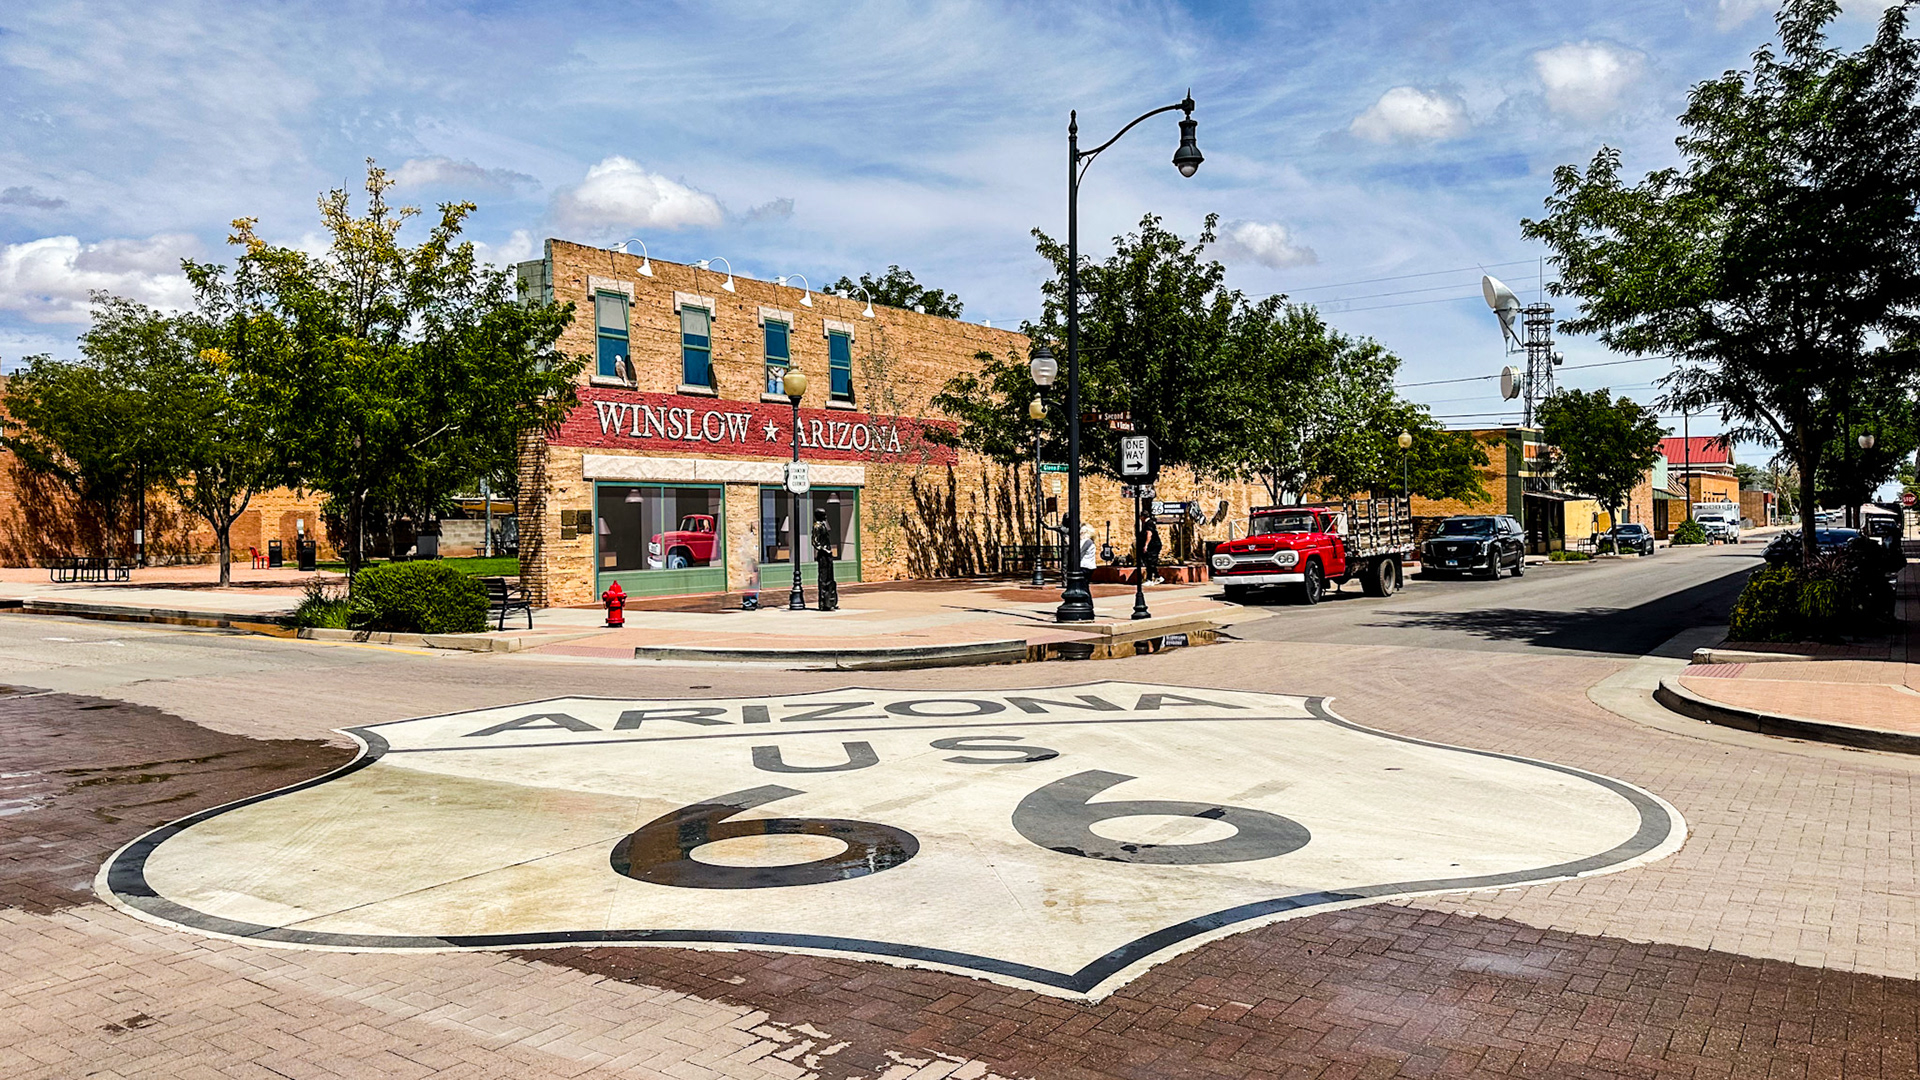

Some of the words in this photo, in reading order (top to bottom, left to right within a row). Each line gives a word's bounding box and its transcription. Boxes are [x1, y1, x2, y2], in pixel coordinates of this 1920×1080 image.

[593, 400, 752, 443] WINSLOW
[789, 416, 902, 454] ARIZONA
[1126, 440, 1145, 450] ONE
[1125, 450, 1145, 460] WAY
[1152, 505, 1163, 514] 66
[462, 692, 1250, 738] ARIZONA
